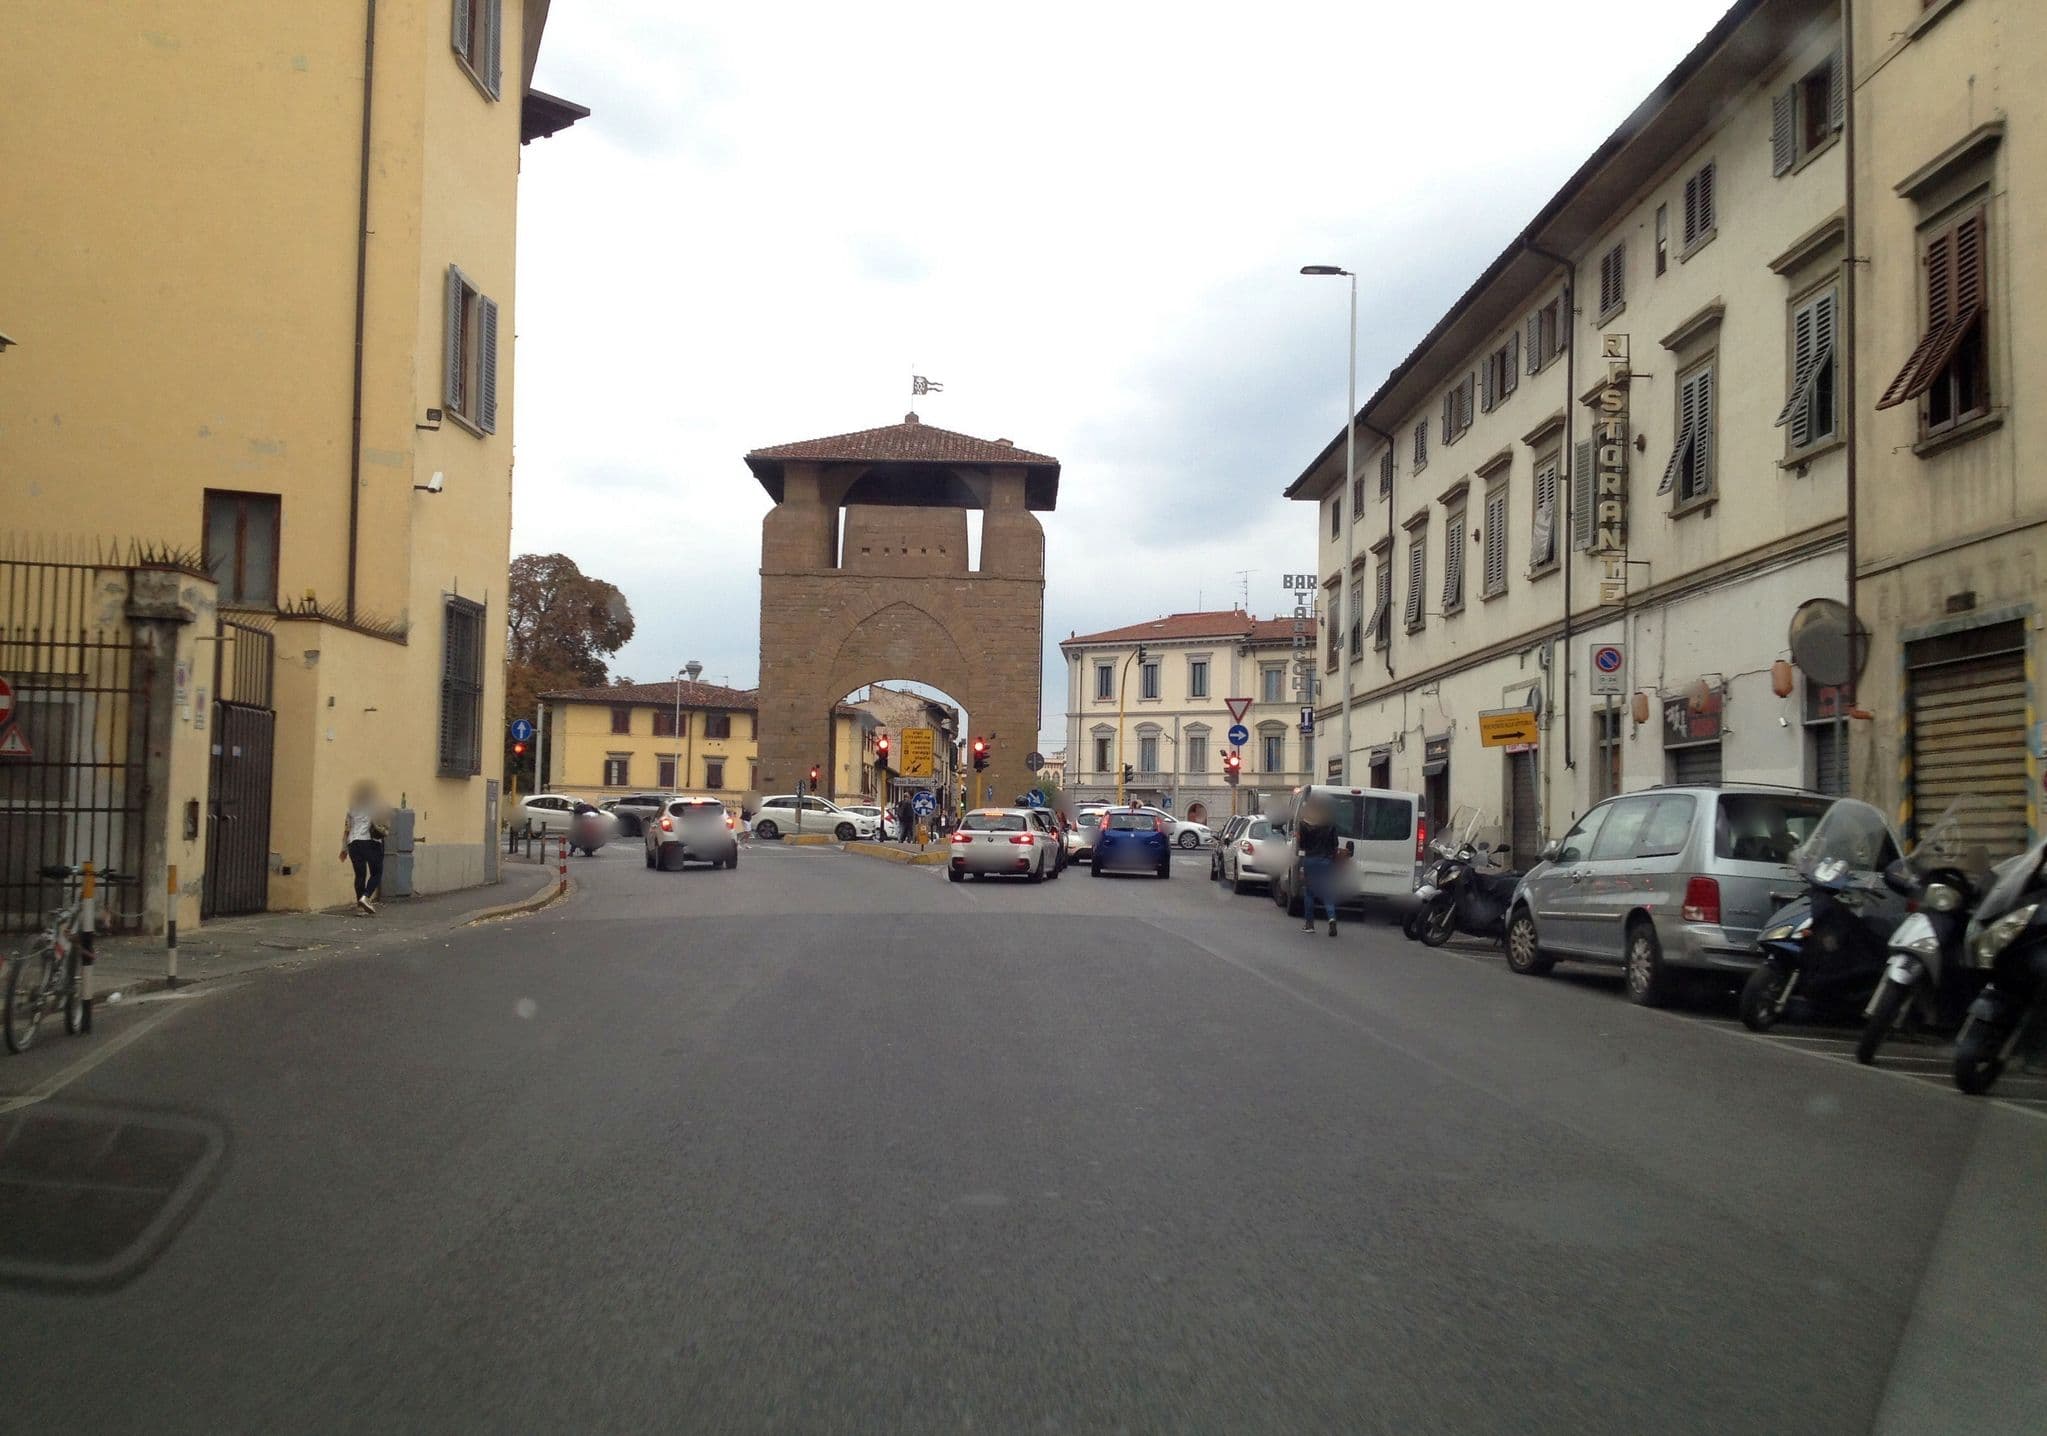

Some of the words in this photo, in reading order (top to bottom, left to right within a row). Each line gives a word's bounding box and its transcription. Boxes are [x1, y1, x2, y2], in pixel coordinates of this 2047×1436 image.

[1600, 334, 1622, 606] RISTORANTE
[1283, 574, 1317, 589] BAR
[1292, 592, 1307, 704] TABACCHI
